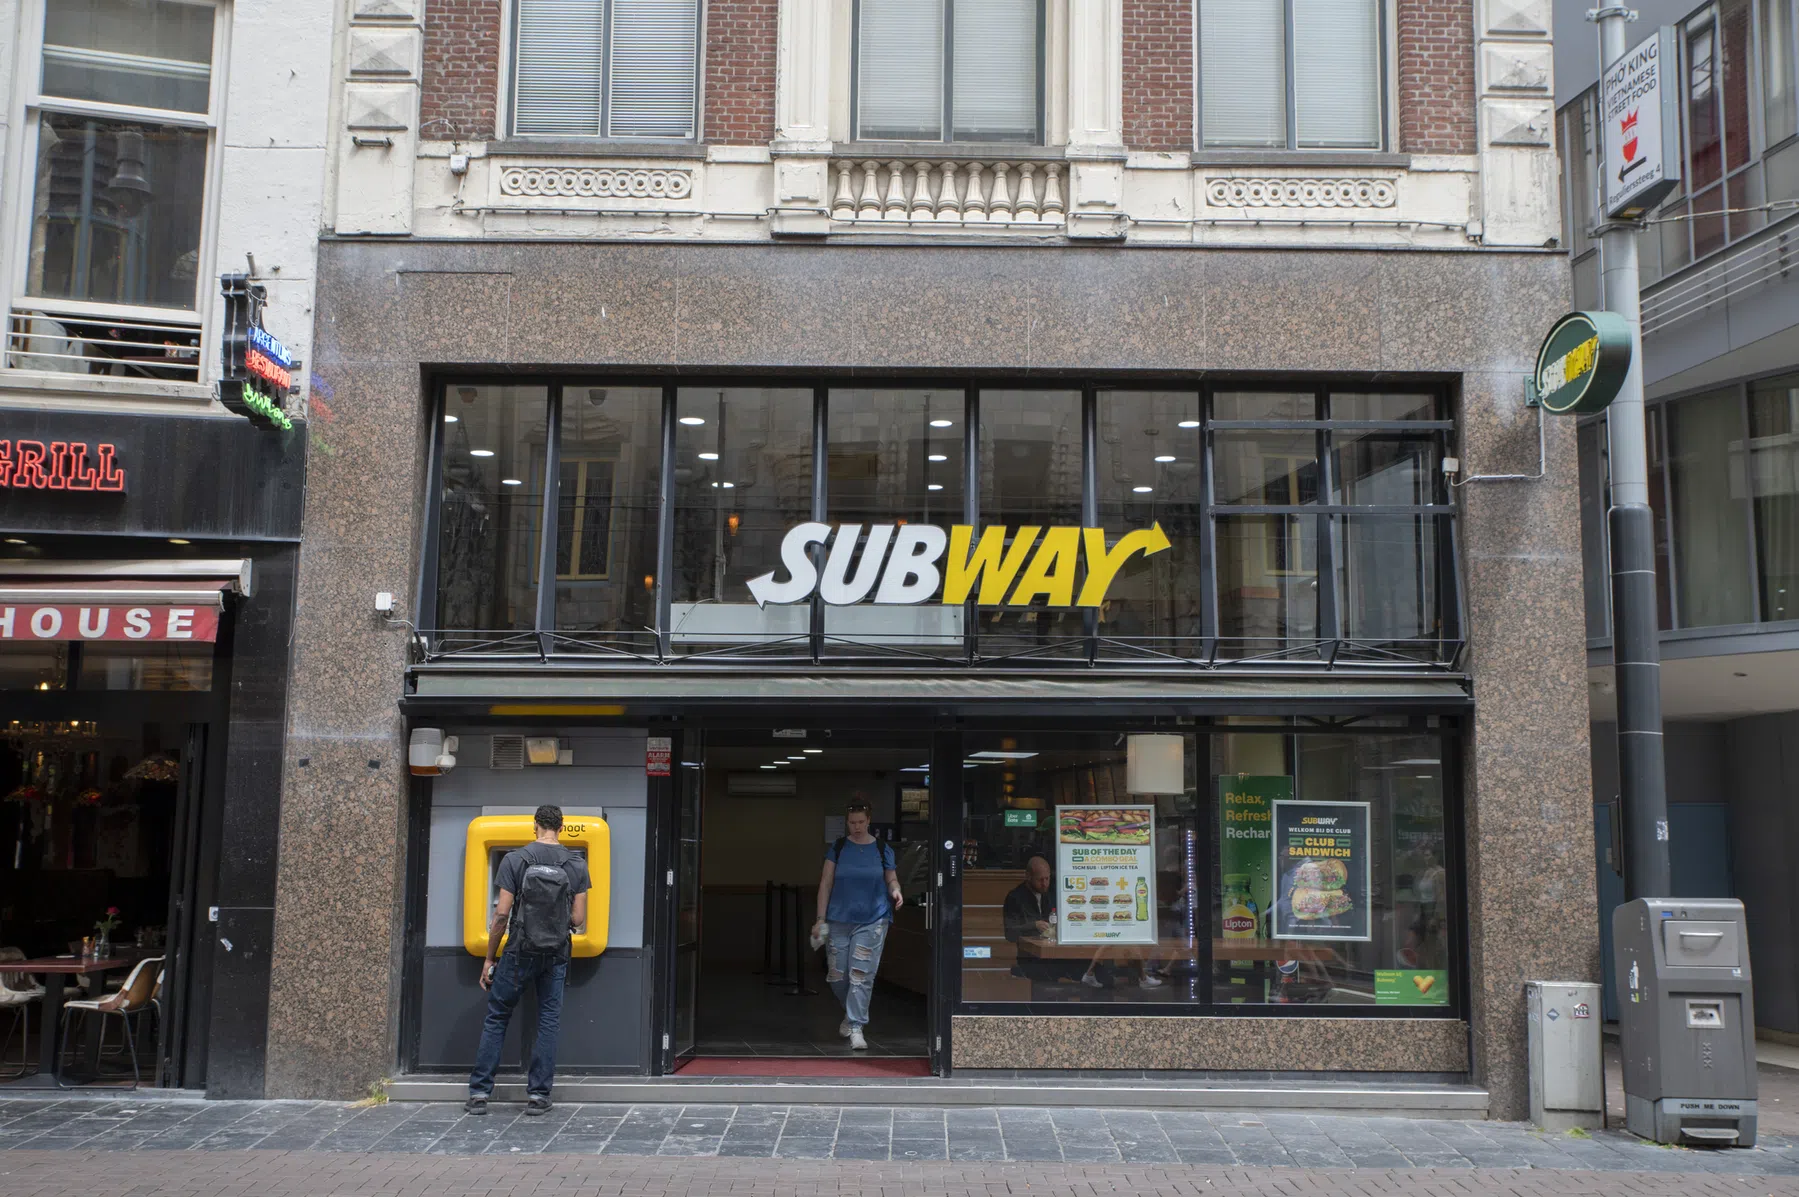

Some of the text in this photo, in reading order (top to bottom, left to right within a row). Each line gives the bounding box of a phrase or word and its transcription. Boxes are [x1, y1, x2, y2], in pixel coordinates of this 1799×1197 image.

[1628, 42, 1657, 74] KING
[1606, 64, 1656, 110] VIETNAMESE
[1608, 78, 1657, 122] STREET FOOD
[1655, 163, 1661, 174] 4
[1538, 334, 1598, 399] SUBWAY
[746, 521, 1171, 611] SUBWAY
[1225, 792, 1265, 806] Relax,
[1226, 827, 1272, 839] Rechar
[1305, 838, 1335, 846] CLUB
[1289, 847, 1351, 857] SANDWICH
[1225, 919, 1252, 929] Lipton
